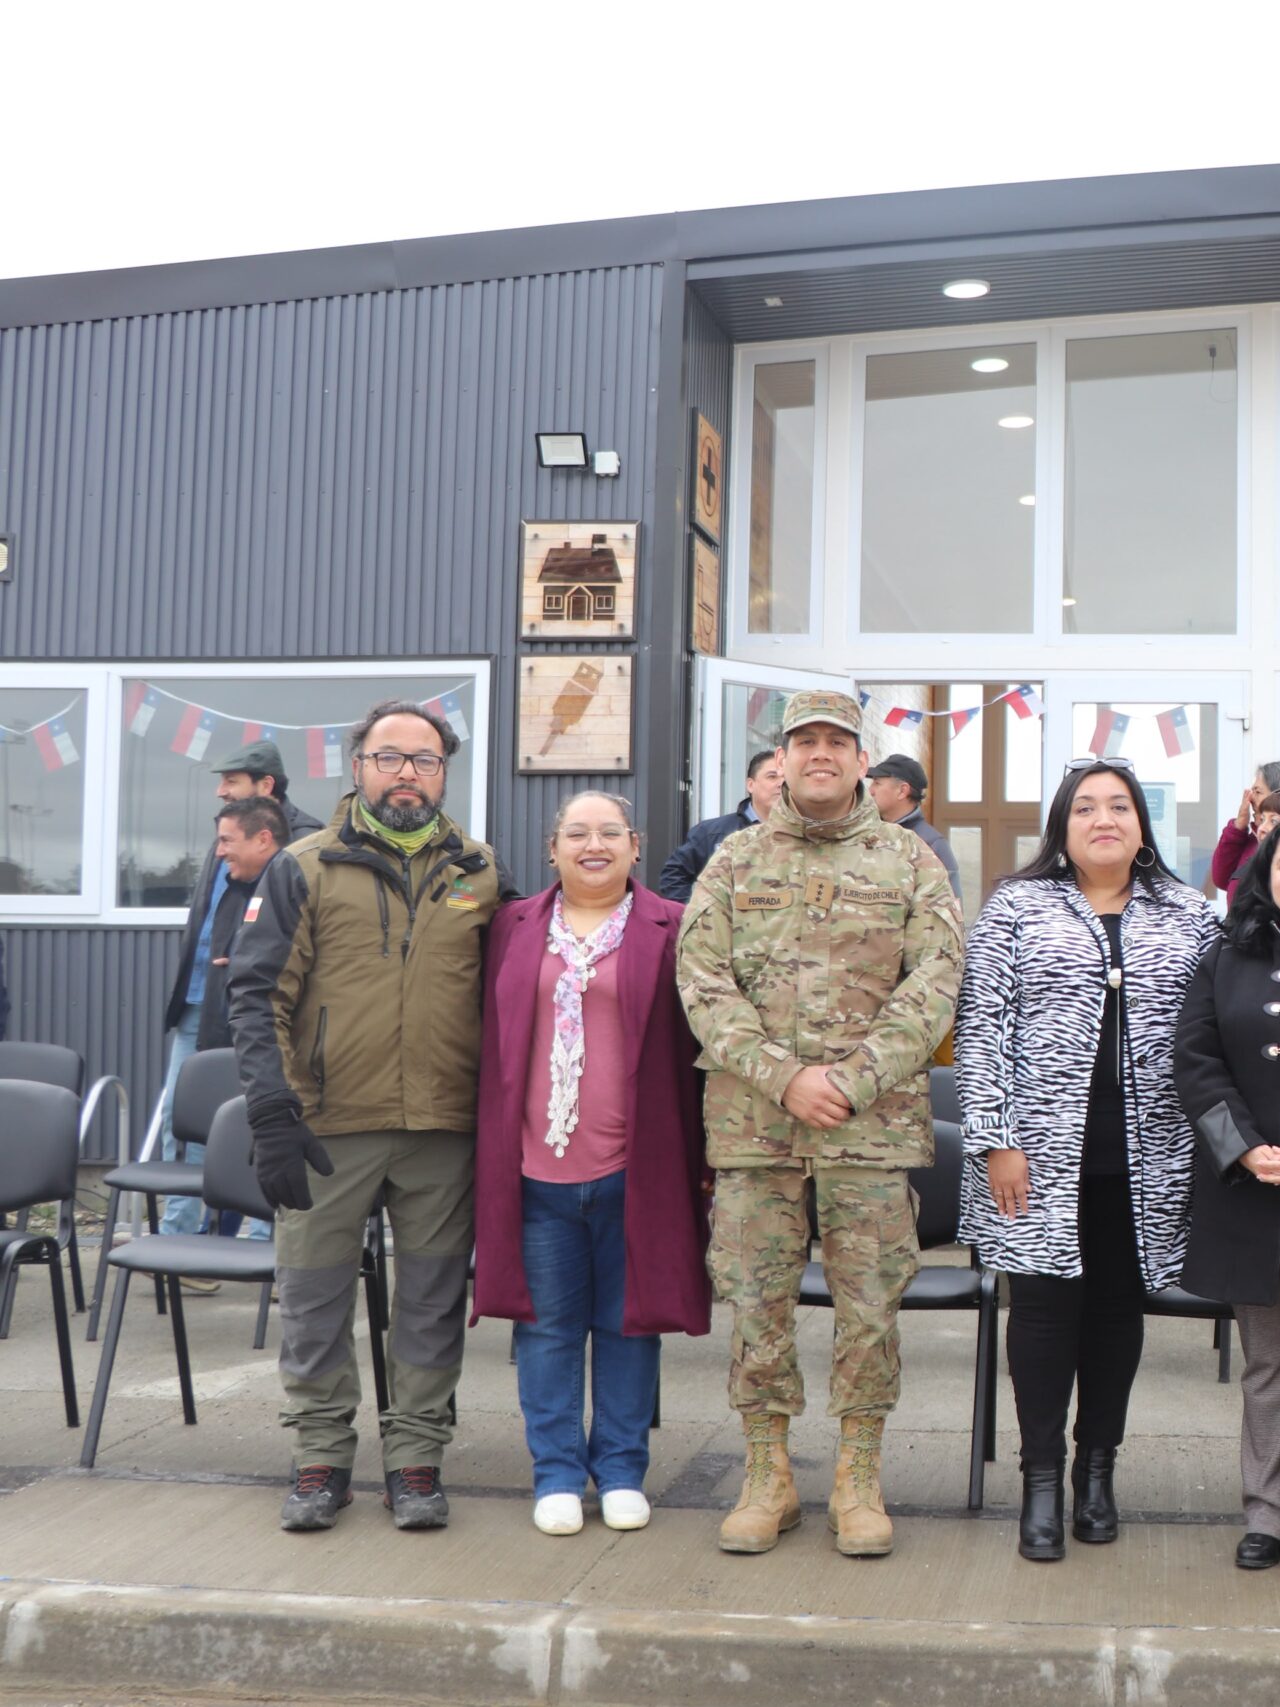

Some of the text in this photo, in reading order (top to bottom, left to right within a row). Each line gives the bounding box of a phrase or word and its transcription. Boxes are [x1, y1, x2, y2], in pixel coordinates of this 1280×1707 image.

[873, 892, 880, 900] DE
[881, 891, 899, 900] CHILE
[748, 897, 781, 905] FERRADA
